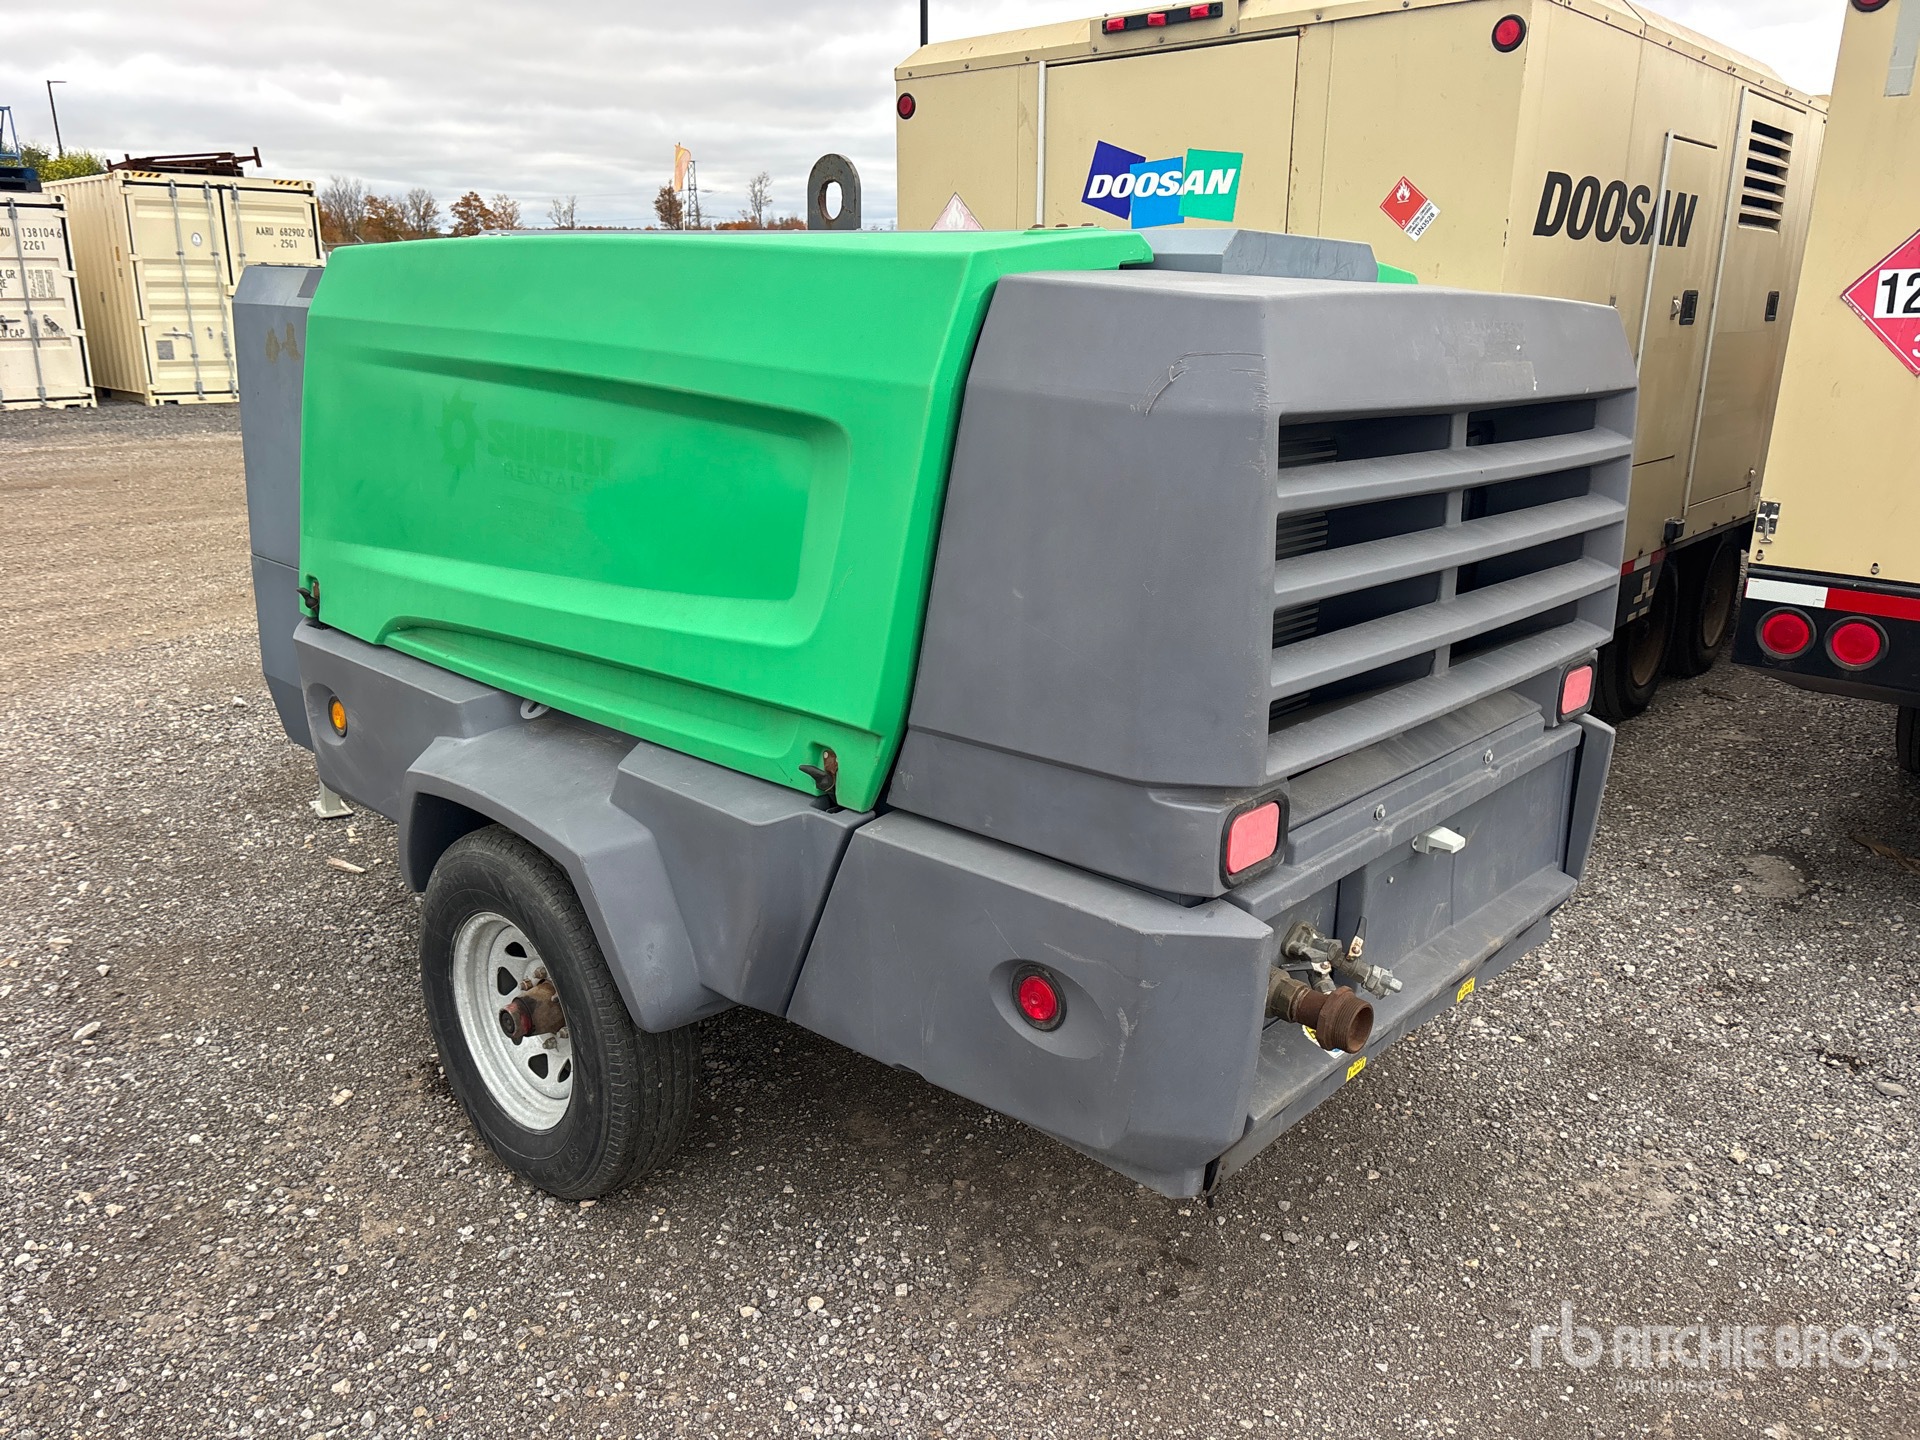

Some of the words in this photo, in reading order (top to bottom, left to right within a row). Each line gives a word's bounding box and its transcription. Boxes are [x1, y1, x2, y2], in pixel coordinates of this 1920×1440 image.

[1087, 168, 1237, 199] DOOSAN
[1533, 170, 1698, 247] DOOSAN
[280, 227, 305, 237] 682902
[23, 240, 45, 251] 22G1
[281, 239, 297, 249] 25G1
